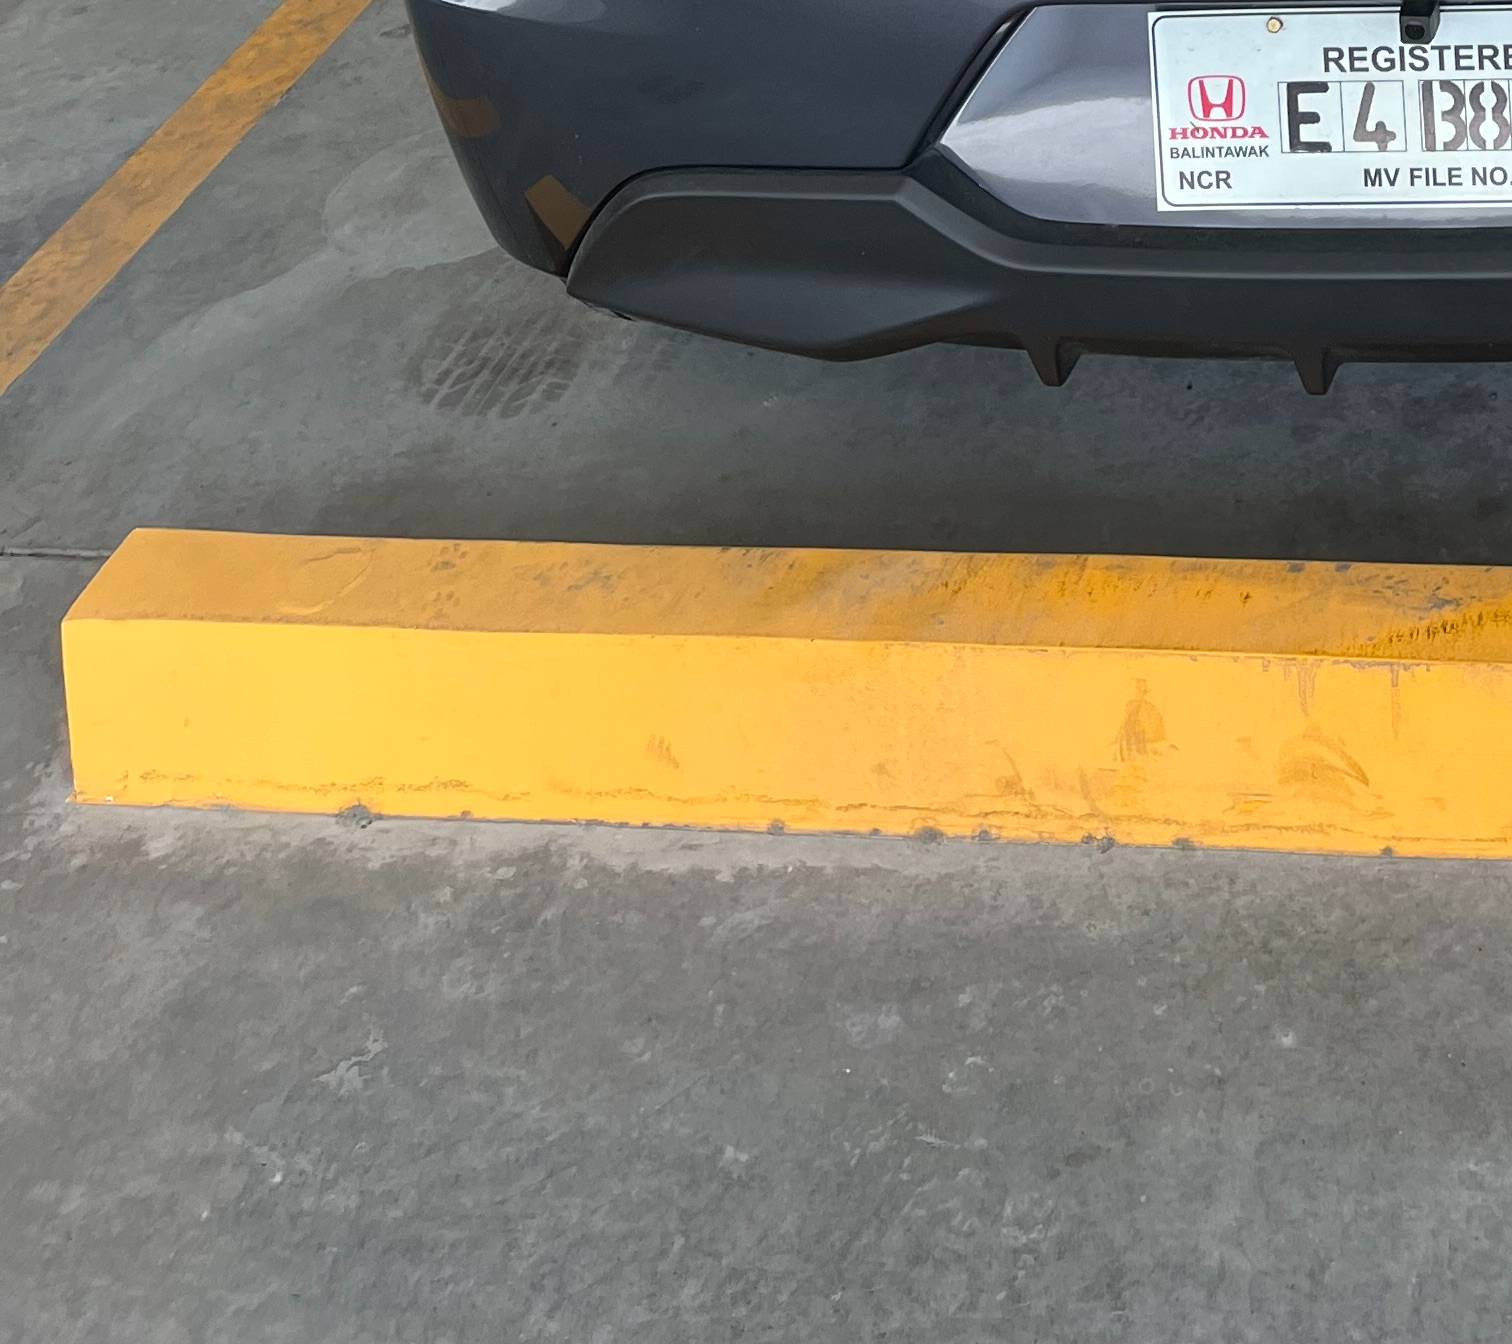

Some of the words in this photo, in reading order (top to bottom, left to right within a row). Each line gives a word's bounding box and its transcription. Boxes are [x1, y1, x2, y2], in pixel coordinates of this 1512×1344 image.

[1169, 126, 1269, 140] HONDA
[1170, 145, 1269, 159] BALINTAWAK
[1179, 170, 1232, 190] NCR
[1363, 167, 1400, 187] MV
[1409, 166, 1462, 187] FILE
